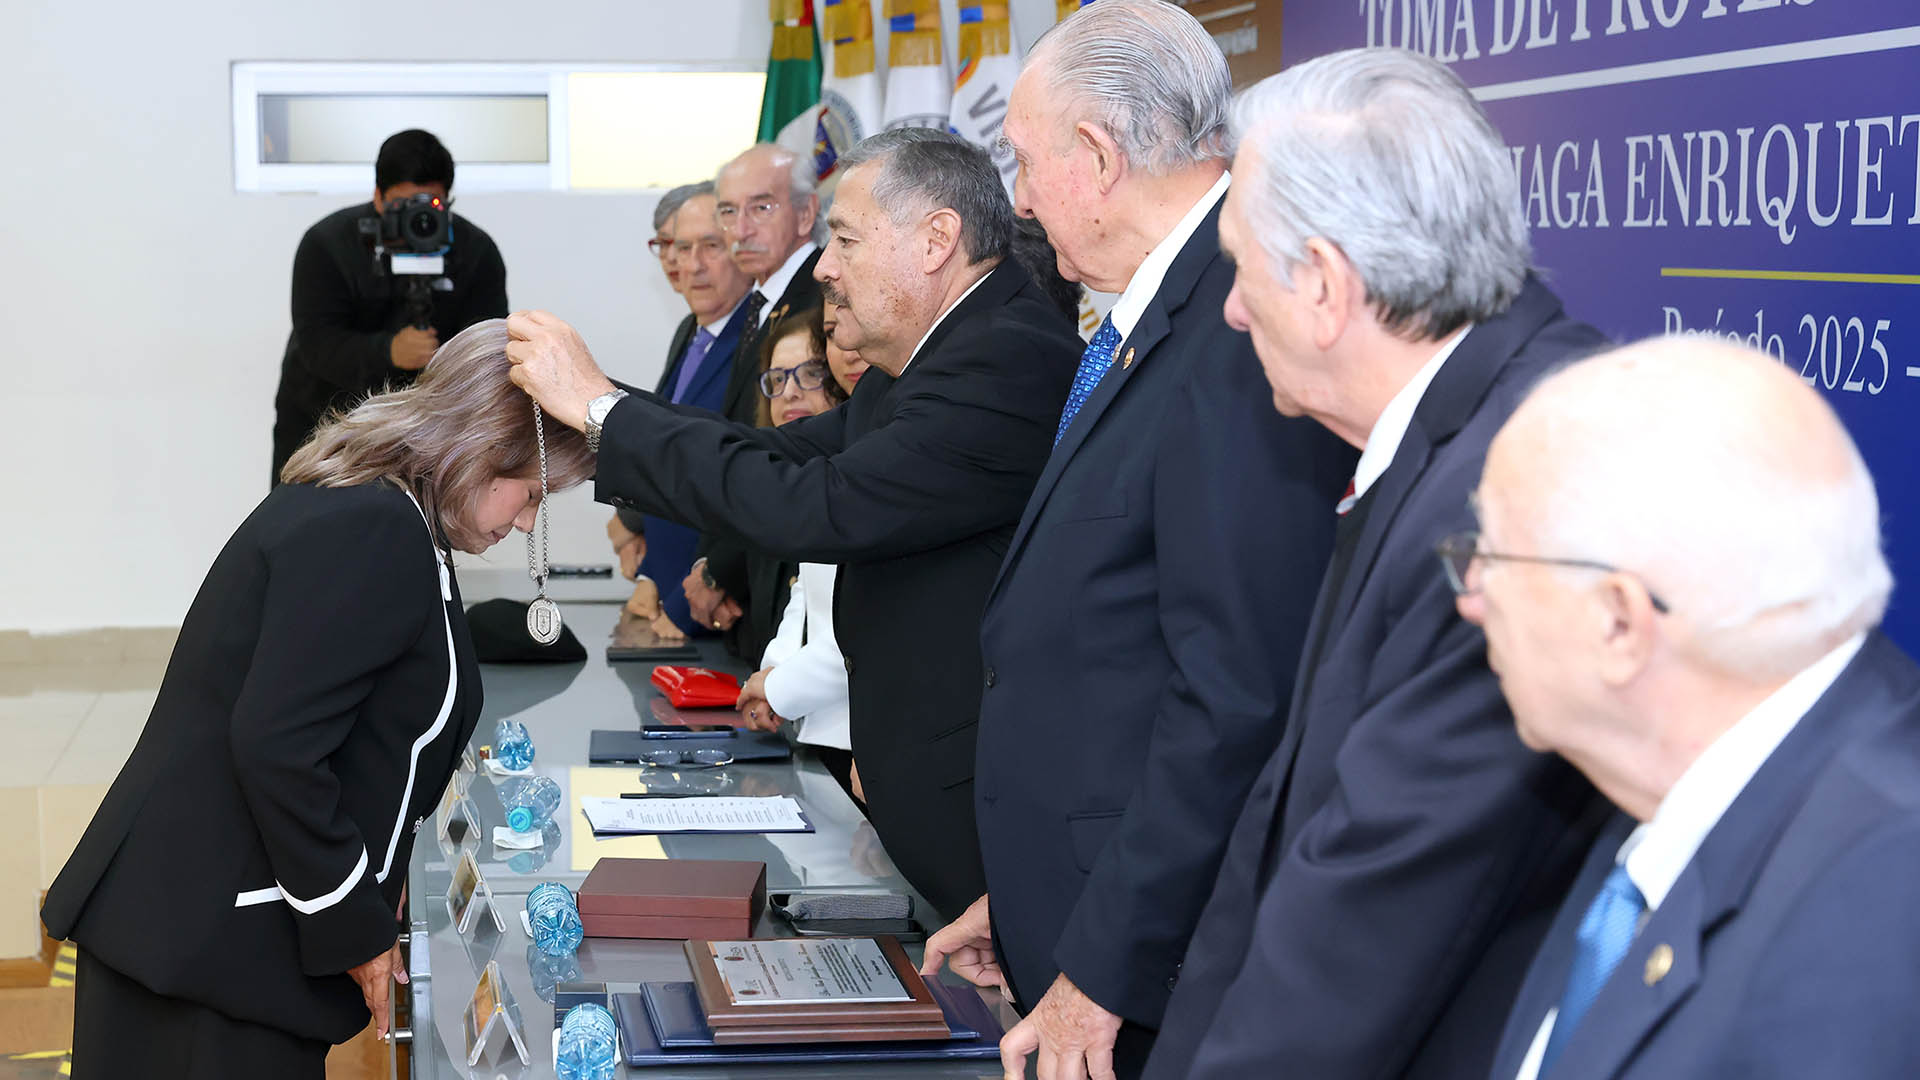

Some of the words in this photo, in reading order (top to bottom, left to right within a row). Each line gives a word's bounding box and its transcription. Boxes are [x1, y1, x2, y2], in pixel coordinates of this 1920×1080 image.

[1359, 0, 1481, 63] TOMA
[1489, 0, 1558, 56] DE
[1798, 313, 1890, 395] 2025
